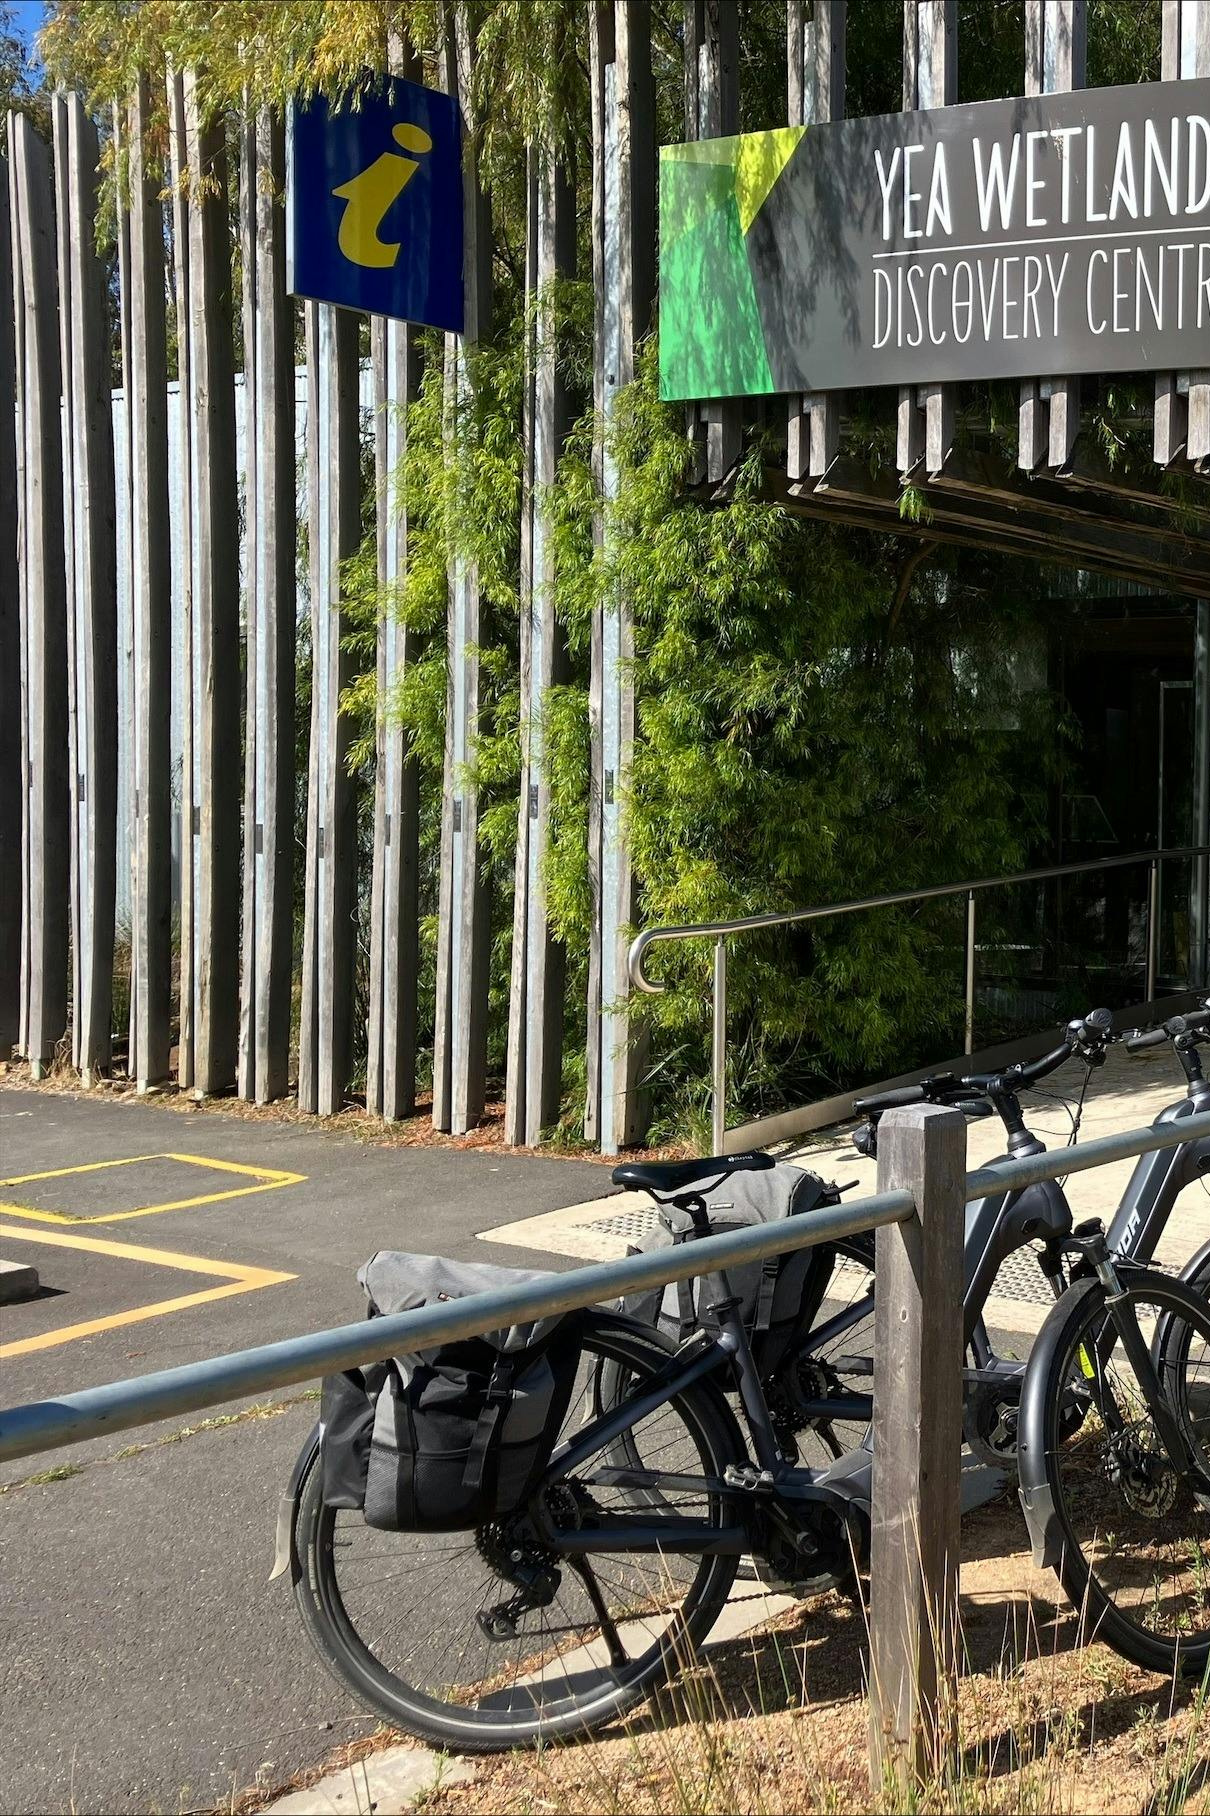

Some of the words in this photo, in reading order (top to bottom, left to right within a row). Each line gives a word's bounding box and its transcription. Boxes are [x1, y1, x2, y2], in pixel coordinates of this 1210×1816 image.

[331, 122, 433, 268] i
[874, 142, 953, 241] YEA
[872, 253, 1070, 349] DISCOVERY
